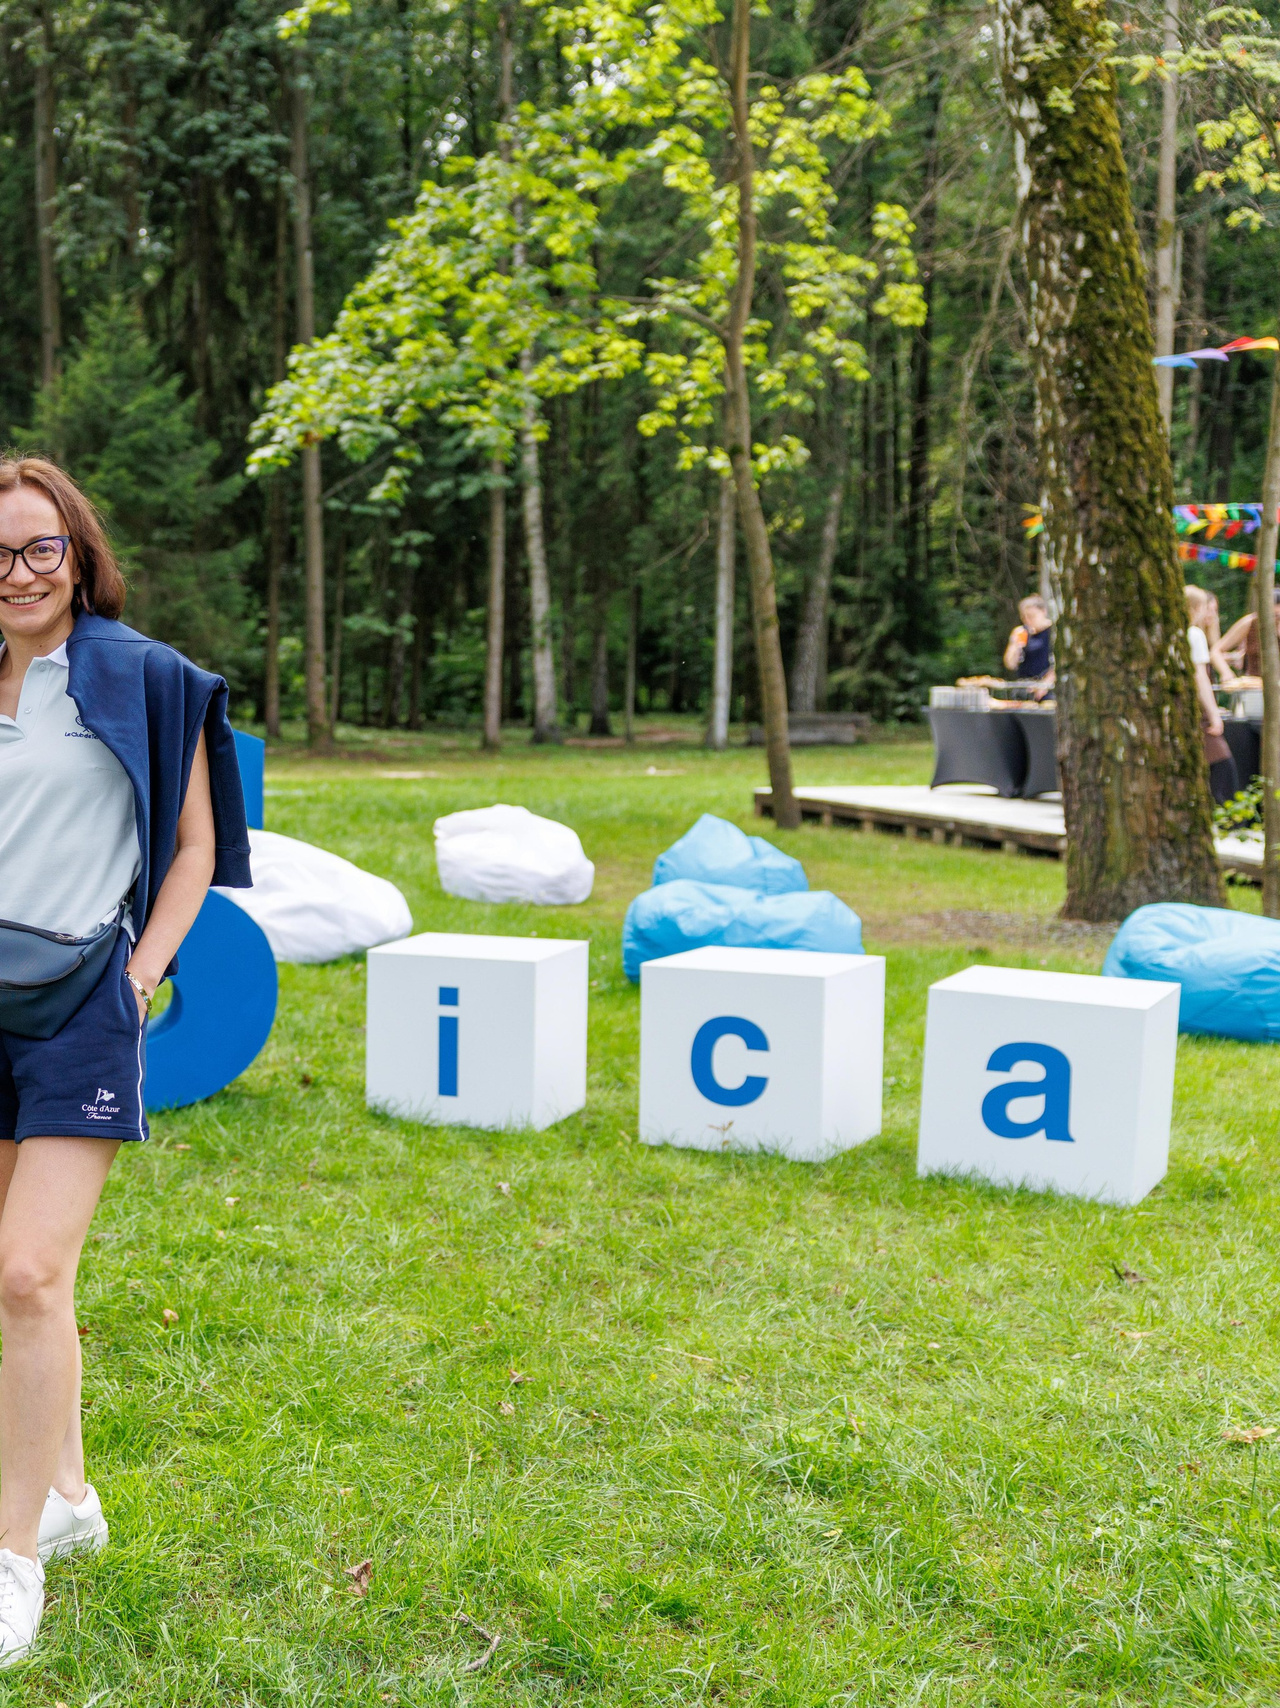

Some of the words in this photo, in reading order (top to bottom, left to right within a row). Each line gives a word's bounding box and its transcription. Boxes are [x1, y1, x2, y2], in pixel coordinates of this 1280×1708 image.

[81, 1104, 98, 1112] Côte
[99, 1105, 120, 1113] d'Azur
[86, 1112, 112, 1120] France
